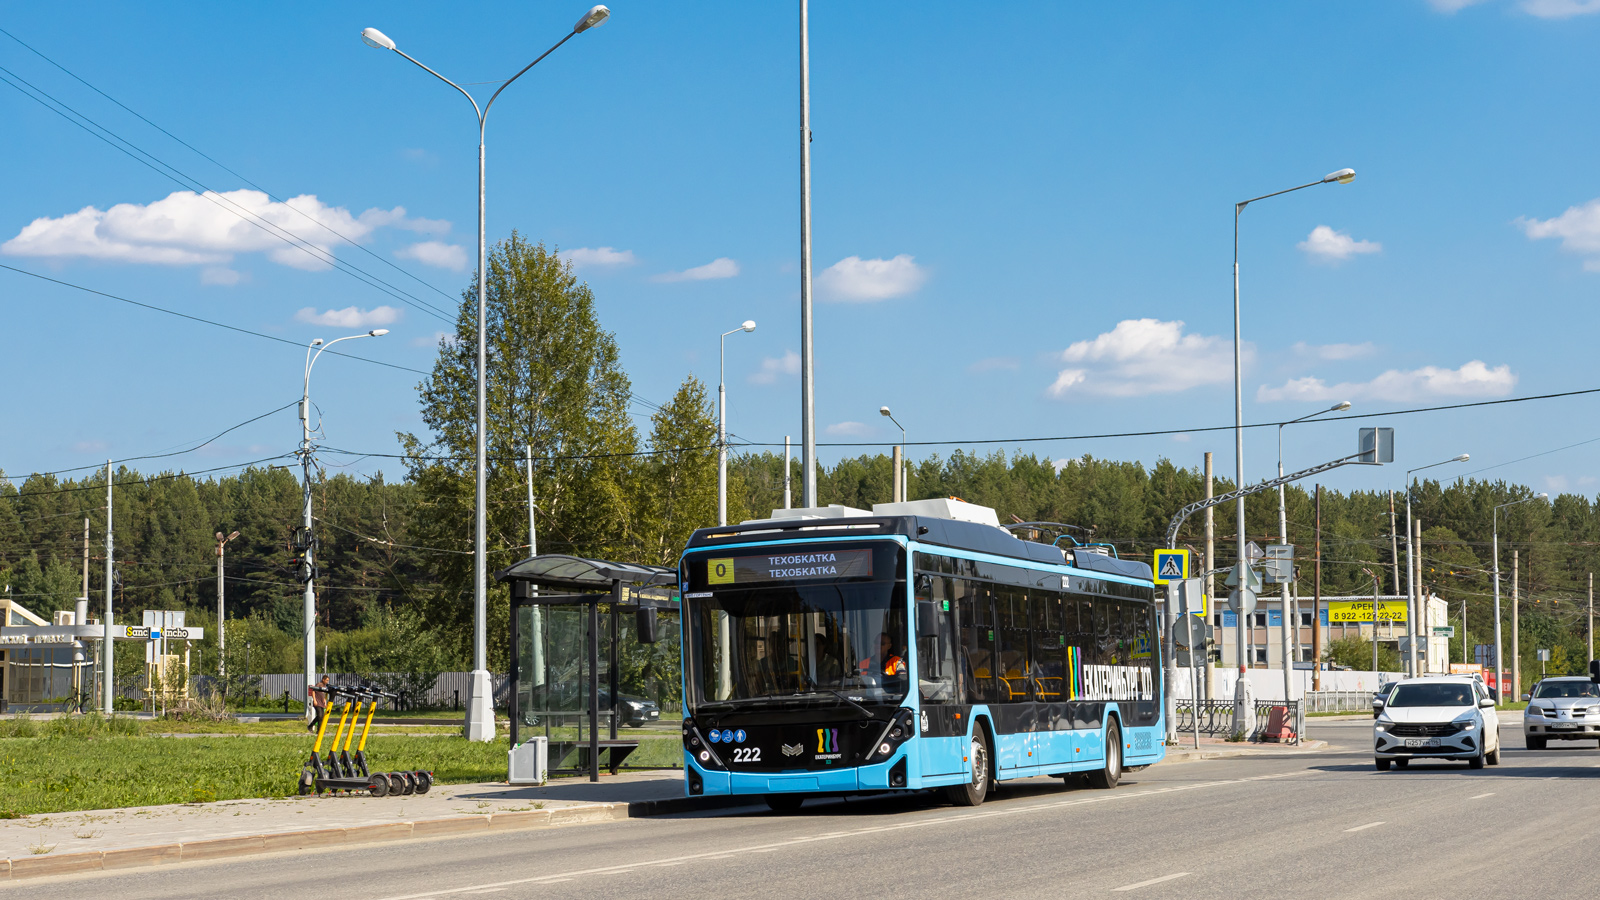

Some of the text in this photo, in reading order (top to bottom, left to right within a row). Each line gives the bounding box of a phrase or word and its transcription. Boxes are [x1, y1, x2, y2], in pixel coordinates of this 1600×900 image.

[768, 553, 837, 566] ТЕХОБКАТКА
[715, 563, 727, 578] 0
[769, 566, 837, 578] ТЕХОБКАТКА
[1334, 611, 1402, 620] 8 922 -12-22-22
[126, 626, 149, 637] Sanc
[1083, 664, 1139, 700] ЕКАТЕРИНБУРГ
[734, 747, 761, 762] 222
